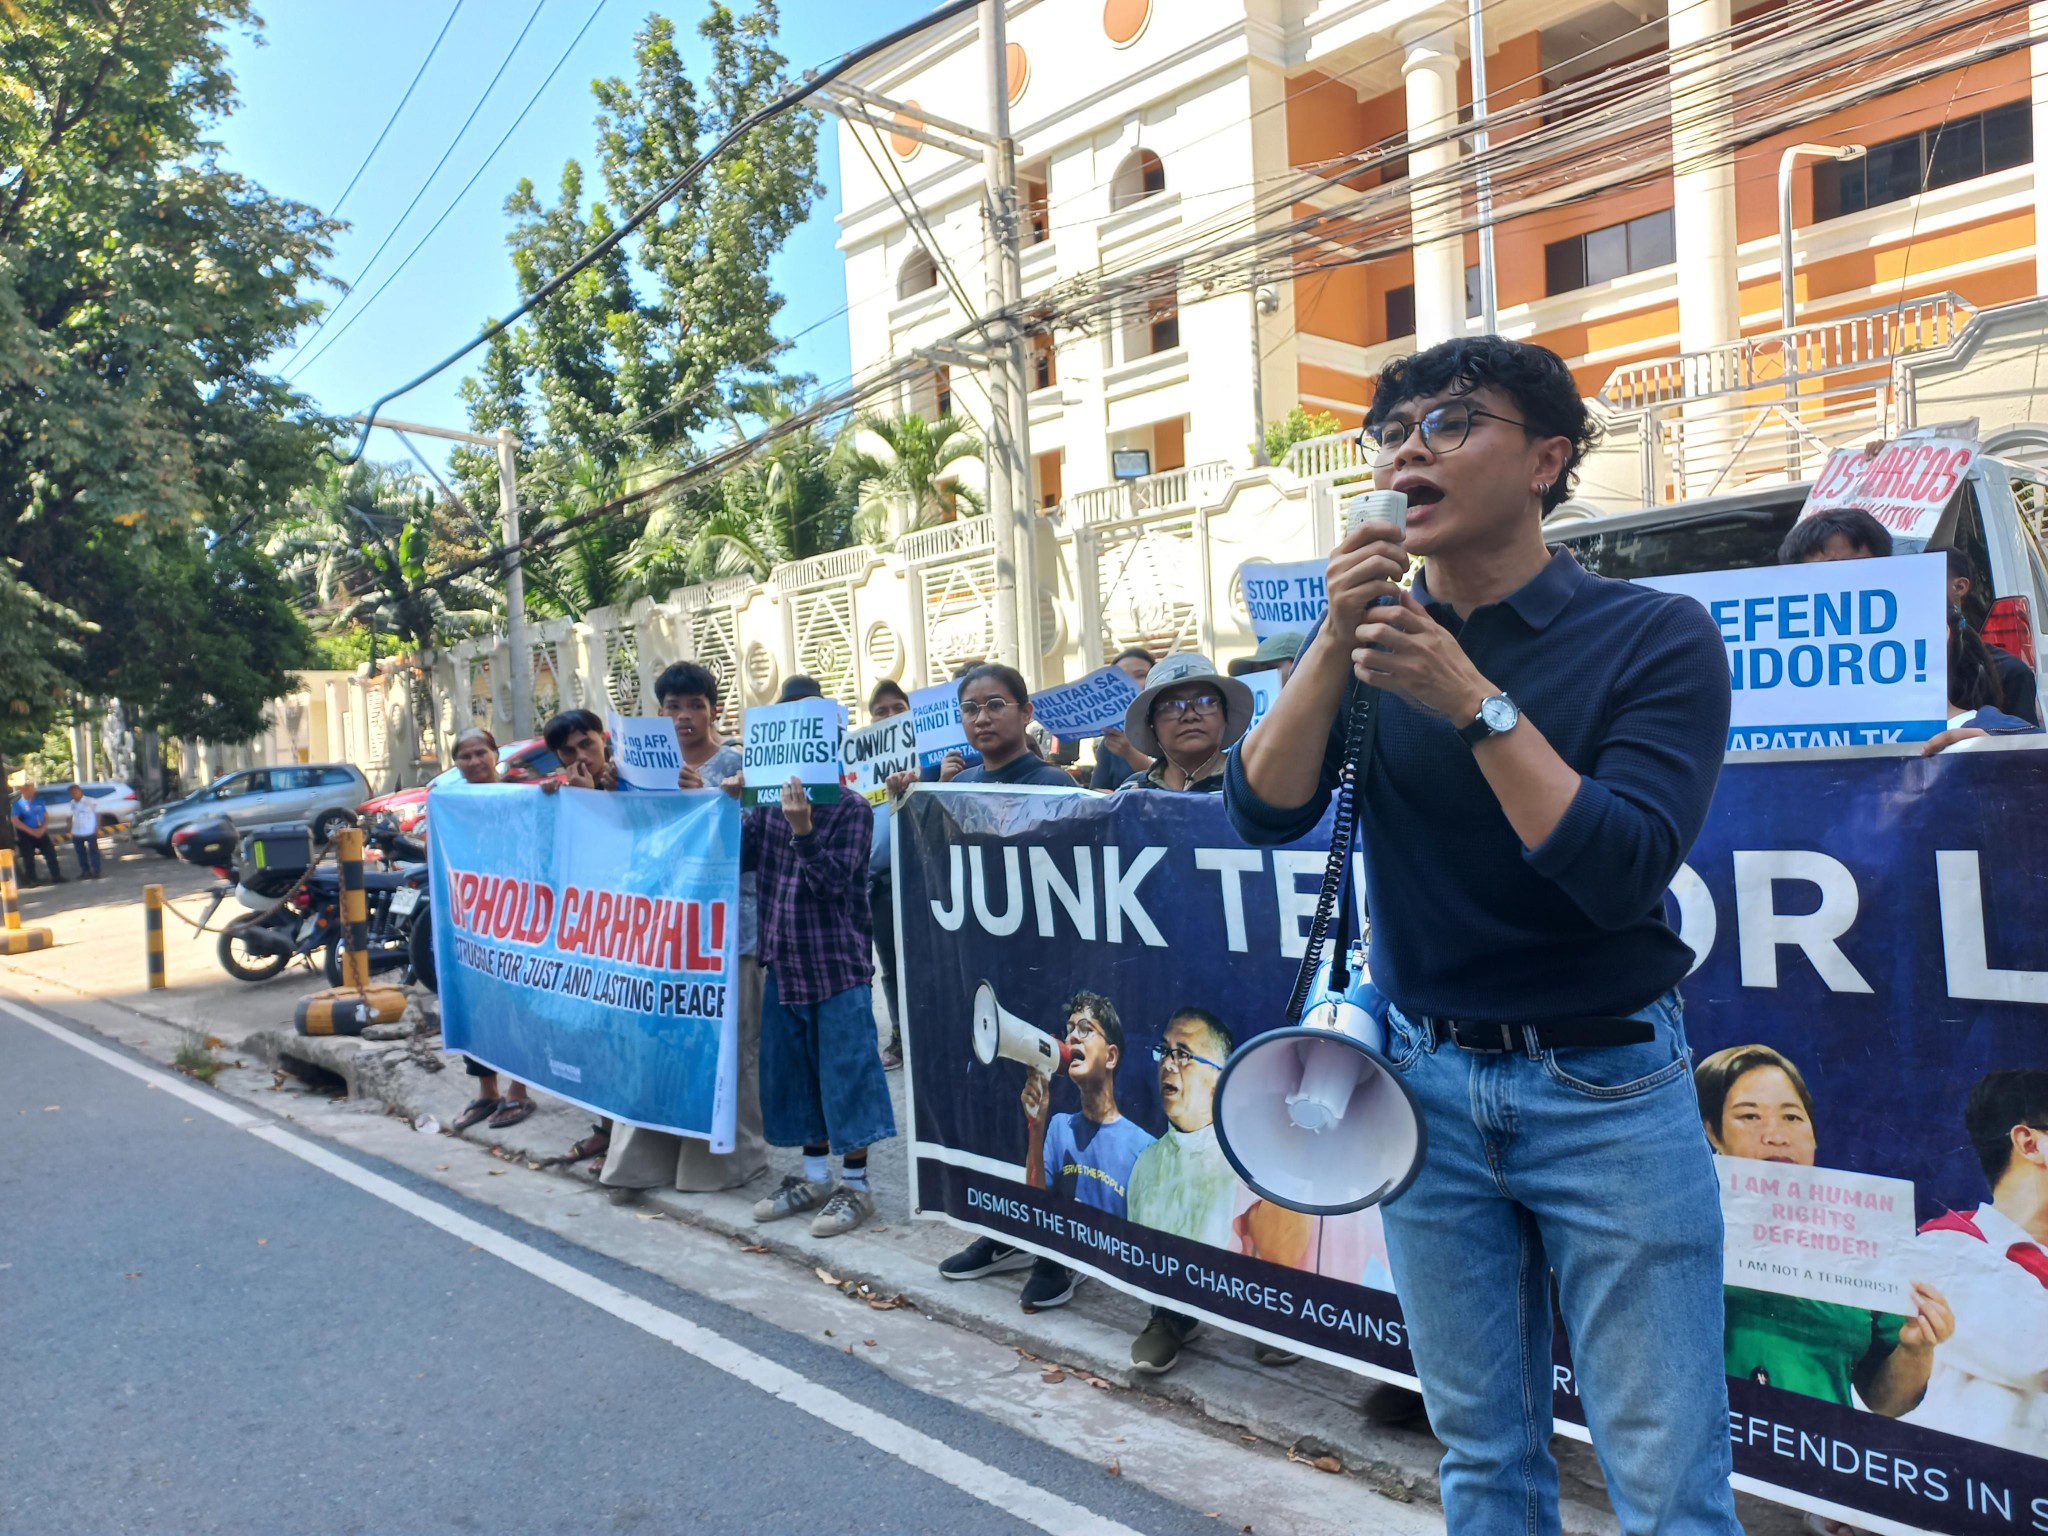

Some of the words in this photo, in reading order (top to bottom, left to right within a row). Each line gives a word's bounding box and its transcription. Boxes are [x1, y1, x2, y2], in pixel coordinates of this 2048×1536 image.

[1247, 580, 1289, 600] STOP
[1294, 577, 1329, 599] TH
[1710, 589, 1897, 642] EFEND
[912, 699, 949, 717] PAGKAIN
[1031, 683, 1095, 710] MILITAR
[1094, 672, 1121, 690] SA
[1034, 682, 1129, 720] KANAYUNAN
[750, 720, 786, 744] STOP
[790, 717, 824, 740] THE
[915, 711, 950, 734] HINDI
[1730, 730, 1849, 751] APATAN
[625, 749, 680, 768] AGUTIN!
[744, 741, 837, 767] BOMBINGS!
[844, 725, 898, 765] CONVICT
[930, 844, 1169, 947] JUNK
[557, 886, 725, 971] CARHRIHL!
[497, 952, 523, 982] FOR
[523, 957, 563, 990] JUST
[560, 965, 592, 997] AND
[593, 971, 654, 1012] LASTING
[660, 982, 726, 1018] PEACE
[1731, 1174, 1737, 1190] I
[1745, 1177, 1779, 1196] AM
[1787, 1182, 1801, 1199] A
[1809, 1184, 1894, 1212] HUMAN
[1772, 1203, 1856, 1231] RIGHTS
[1752, 1223, 1878, 1259] DEFENDER!
[1746, 1260, 1767, 1271] AM
[1772, 1264, 1798, 1277] NOT
[1803, 1270, 1813, 1280] A
[1819, 1272, 1898, 1294] TERRORIST!
[967, 1187, 1030, 1223] DISMISS
[1032, 1207, 1064, 1235] THE
[1067, 1219, 1179, 1277] TRUMPED-UP
[1185, 1263, 1294, 1315] CHARGES
[1729, 1411, 1949, 1502] EFENDERS
[1966, 1478, 2012, 1522] IN
